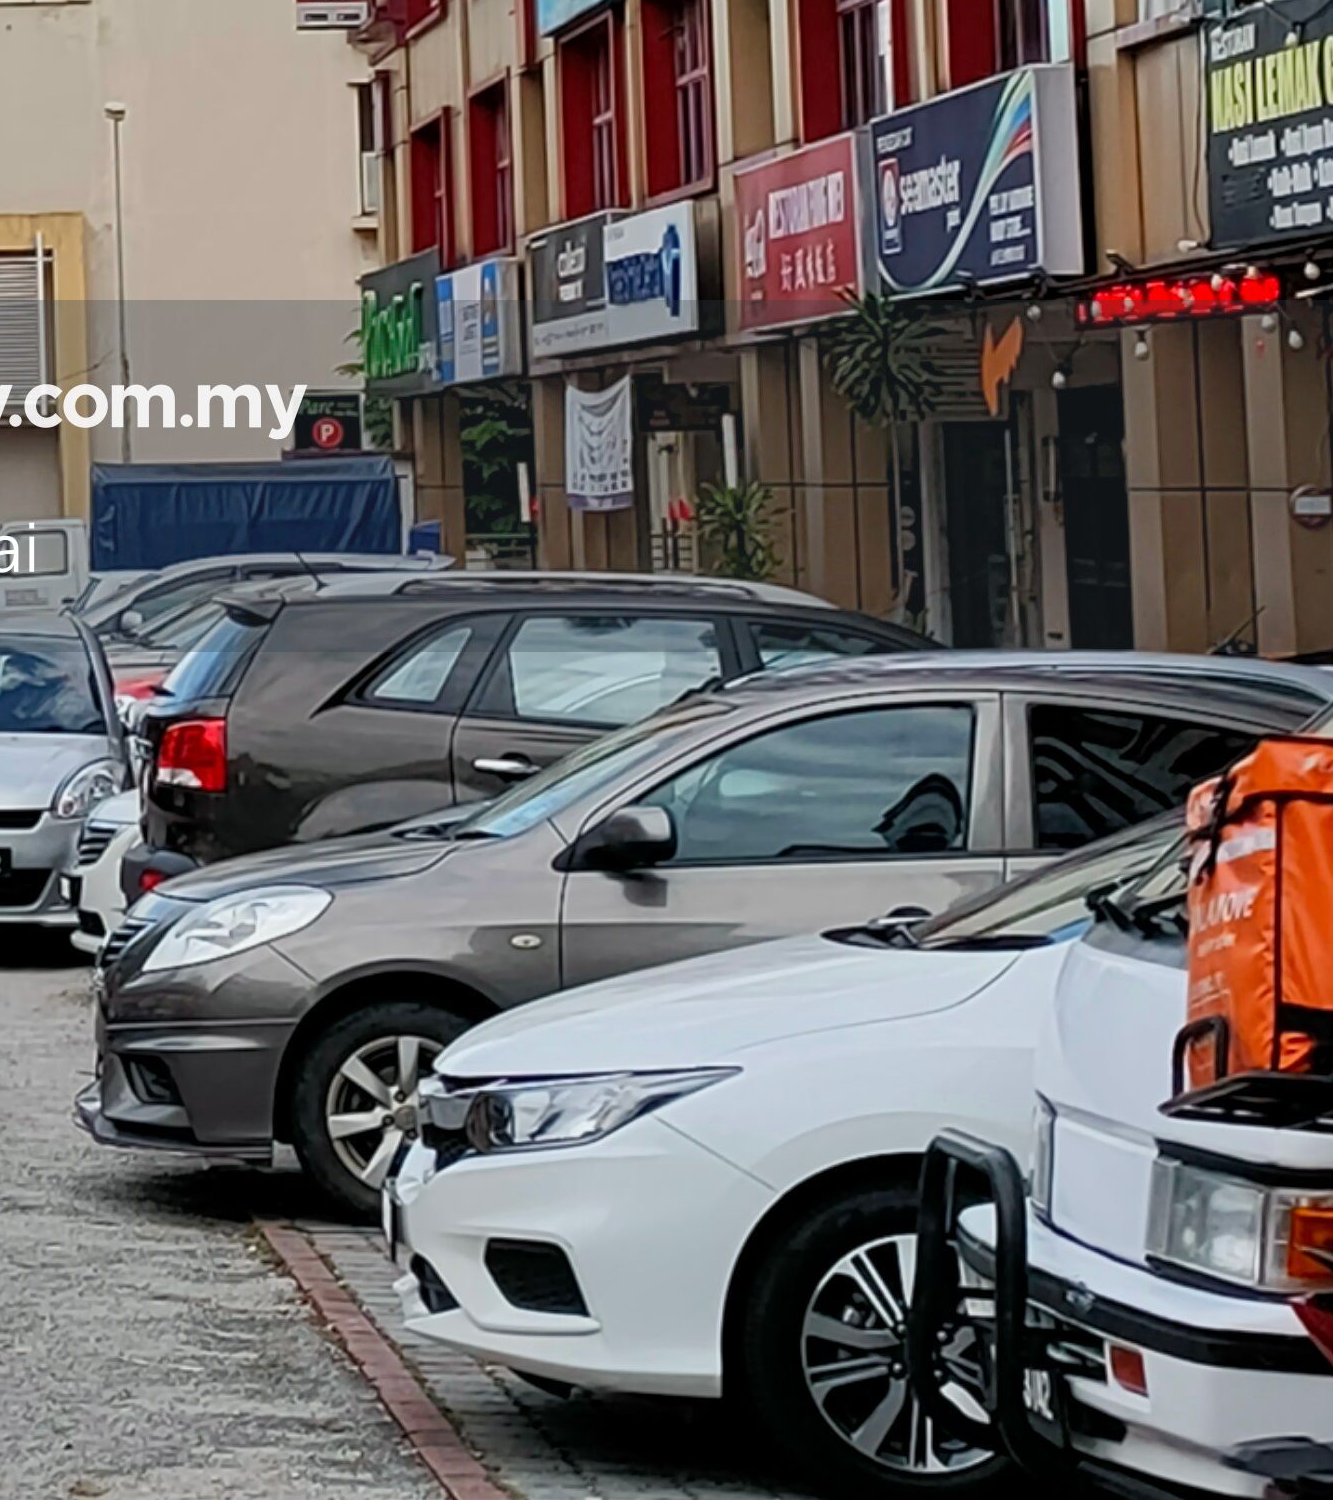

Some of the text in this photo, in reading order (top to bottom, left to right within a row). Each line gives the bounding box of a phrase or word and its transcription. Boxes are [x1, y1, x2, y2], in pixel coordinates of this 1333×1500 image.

[1211, 60, 1254, 133] NASI
[1255, 40, 1323, 122] LEMAK
[900, 155, 961, 215] seamaster
